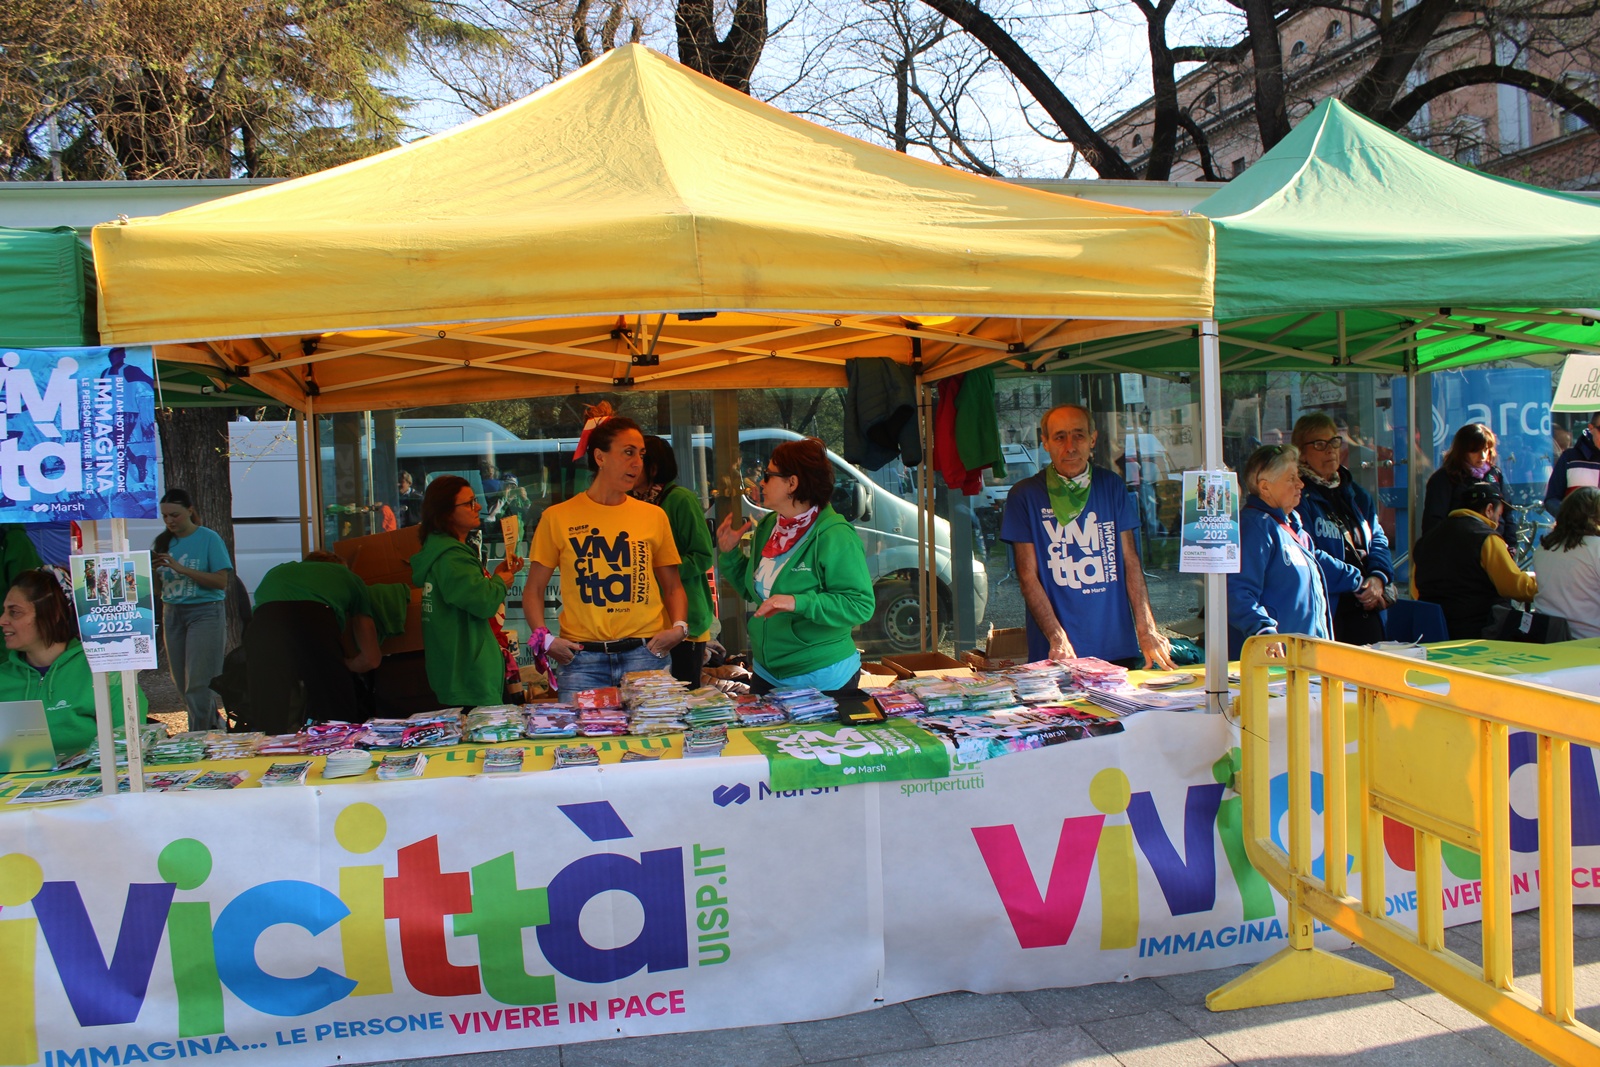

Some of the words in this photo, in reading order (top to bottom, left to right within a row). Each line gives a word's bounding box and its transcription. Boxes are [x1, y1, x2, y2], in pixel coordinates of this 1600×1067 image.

[81, 377, 90, 387] LE
[115, 376, 124, 393] BUT
[82, 389, 92, 428] PERSONE
[116, 399, 124, 413] AM
[116, 413, 124, 433] NOT
[93, 377, 115, 493] IMMAGINA
[116, 433, 125, 450] THE
[83, 429, 92, 459] VIVERE
[84, 461, 93, 470] IN
[116, 451, 125, 474] ONLY
[85, 472, 94, 495] PACE
[117, 474, 126, 493] ONE
[51, 502, 85, 513] Marsh
[1194, 522, 1234, 530] AVVENTURA
[1199, 515, 1231, 523] SOGGIORNI
[1203, 530, 1228, 540] 2025
[1102, 520, 1118, 582] IMMAGINA
[637, 540, 646, 604] IMMAGINA
[85, 611, 143, 623] AVVENTURA
[90, 603, 137, 614] SOGGIORNI
[98, 620, 134, 634] 2025
[1040, 729, 1067, 740] Marsh
[858, 764, 887, 775] Marsh
[900, 775, 985, 798] sportpertutti
[693, 843, 731, 967] UISP.IT
[276, 1028, 309, 1047] LE
[313, 1010, 445, 1044] PERSONE
[448, 1003, 559, 1037] VIVERE
[567, 999, 599, 1025] IN
[607, 988, 687, 1020] PACE
